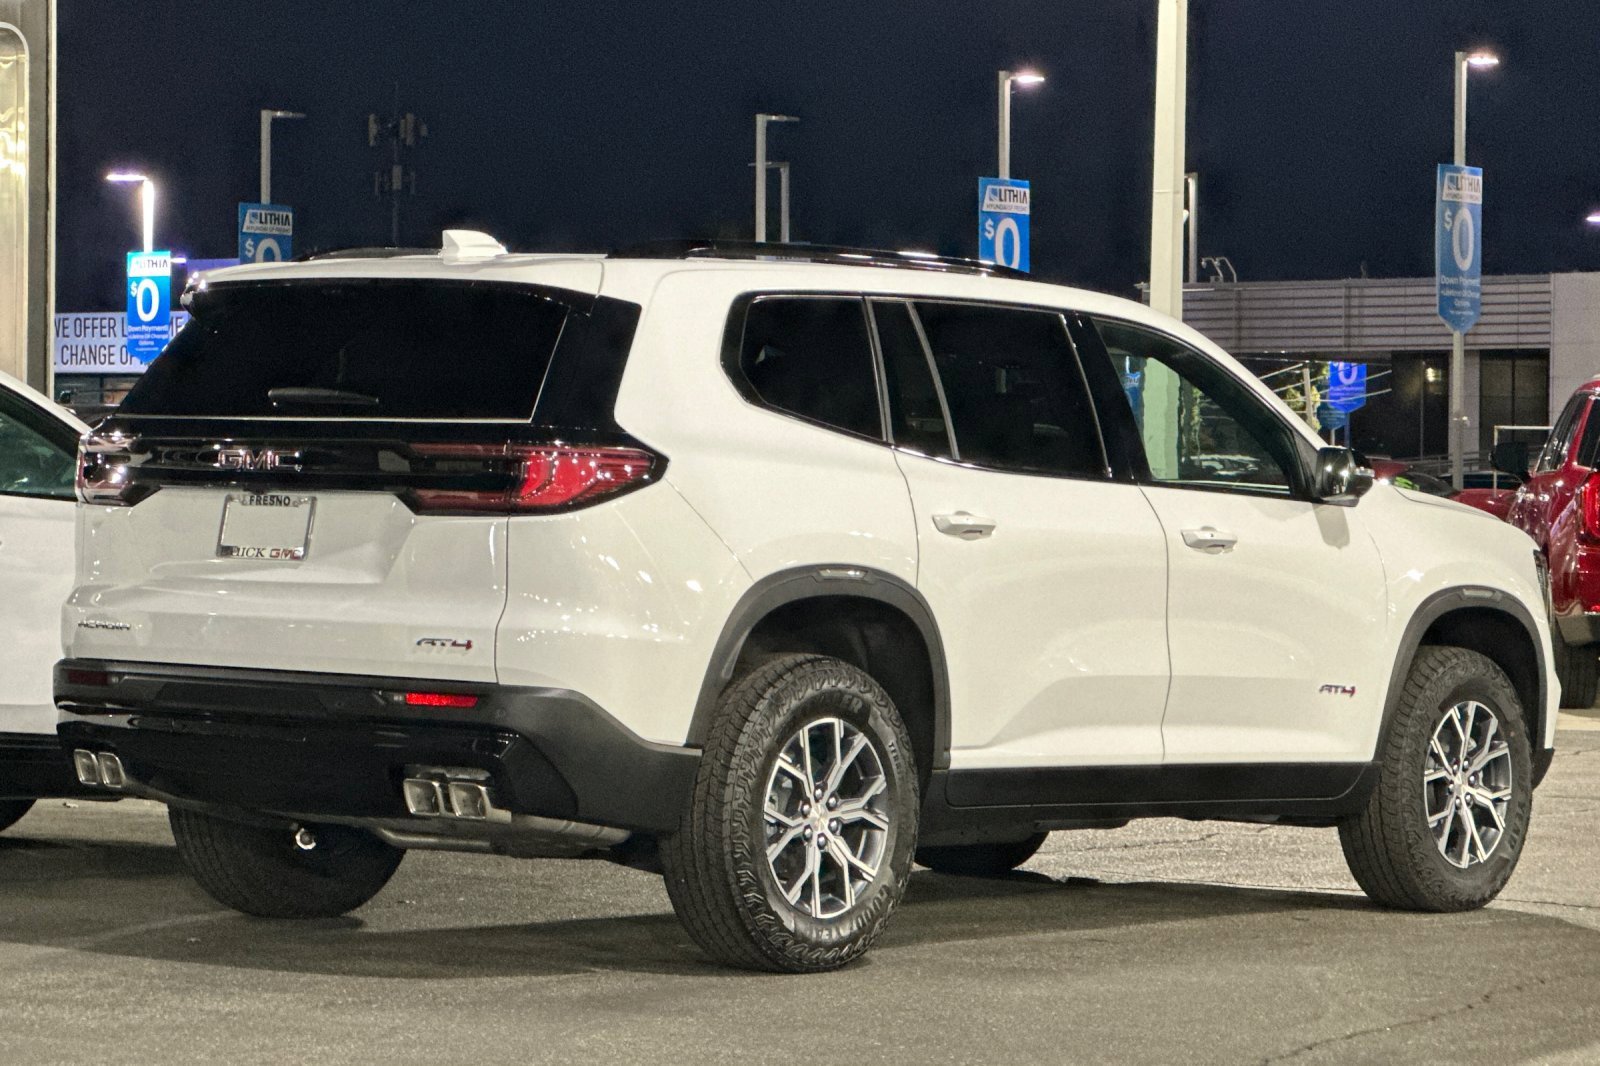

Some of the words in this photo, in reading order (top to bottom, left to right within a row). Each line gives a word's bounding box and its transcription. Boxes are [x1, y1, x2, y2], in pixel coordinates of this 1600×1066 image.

[998, 187, 1028, 204] LITHIA
[259, 211, 291, 226] LITHIA
[73, 316, 117, 338] OFFER
[61, 344, 116, 366] CHANGE
[217, 449, 302, 472] GMC
[248, 495, 291, 508] FRESNO
[269, 548, 305, 560] GMC
[1319, 684, 1356, 698] AT4
